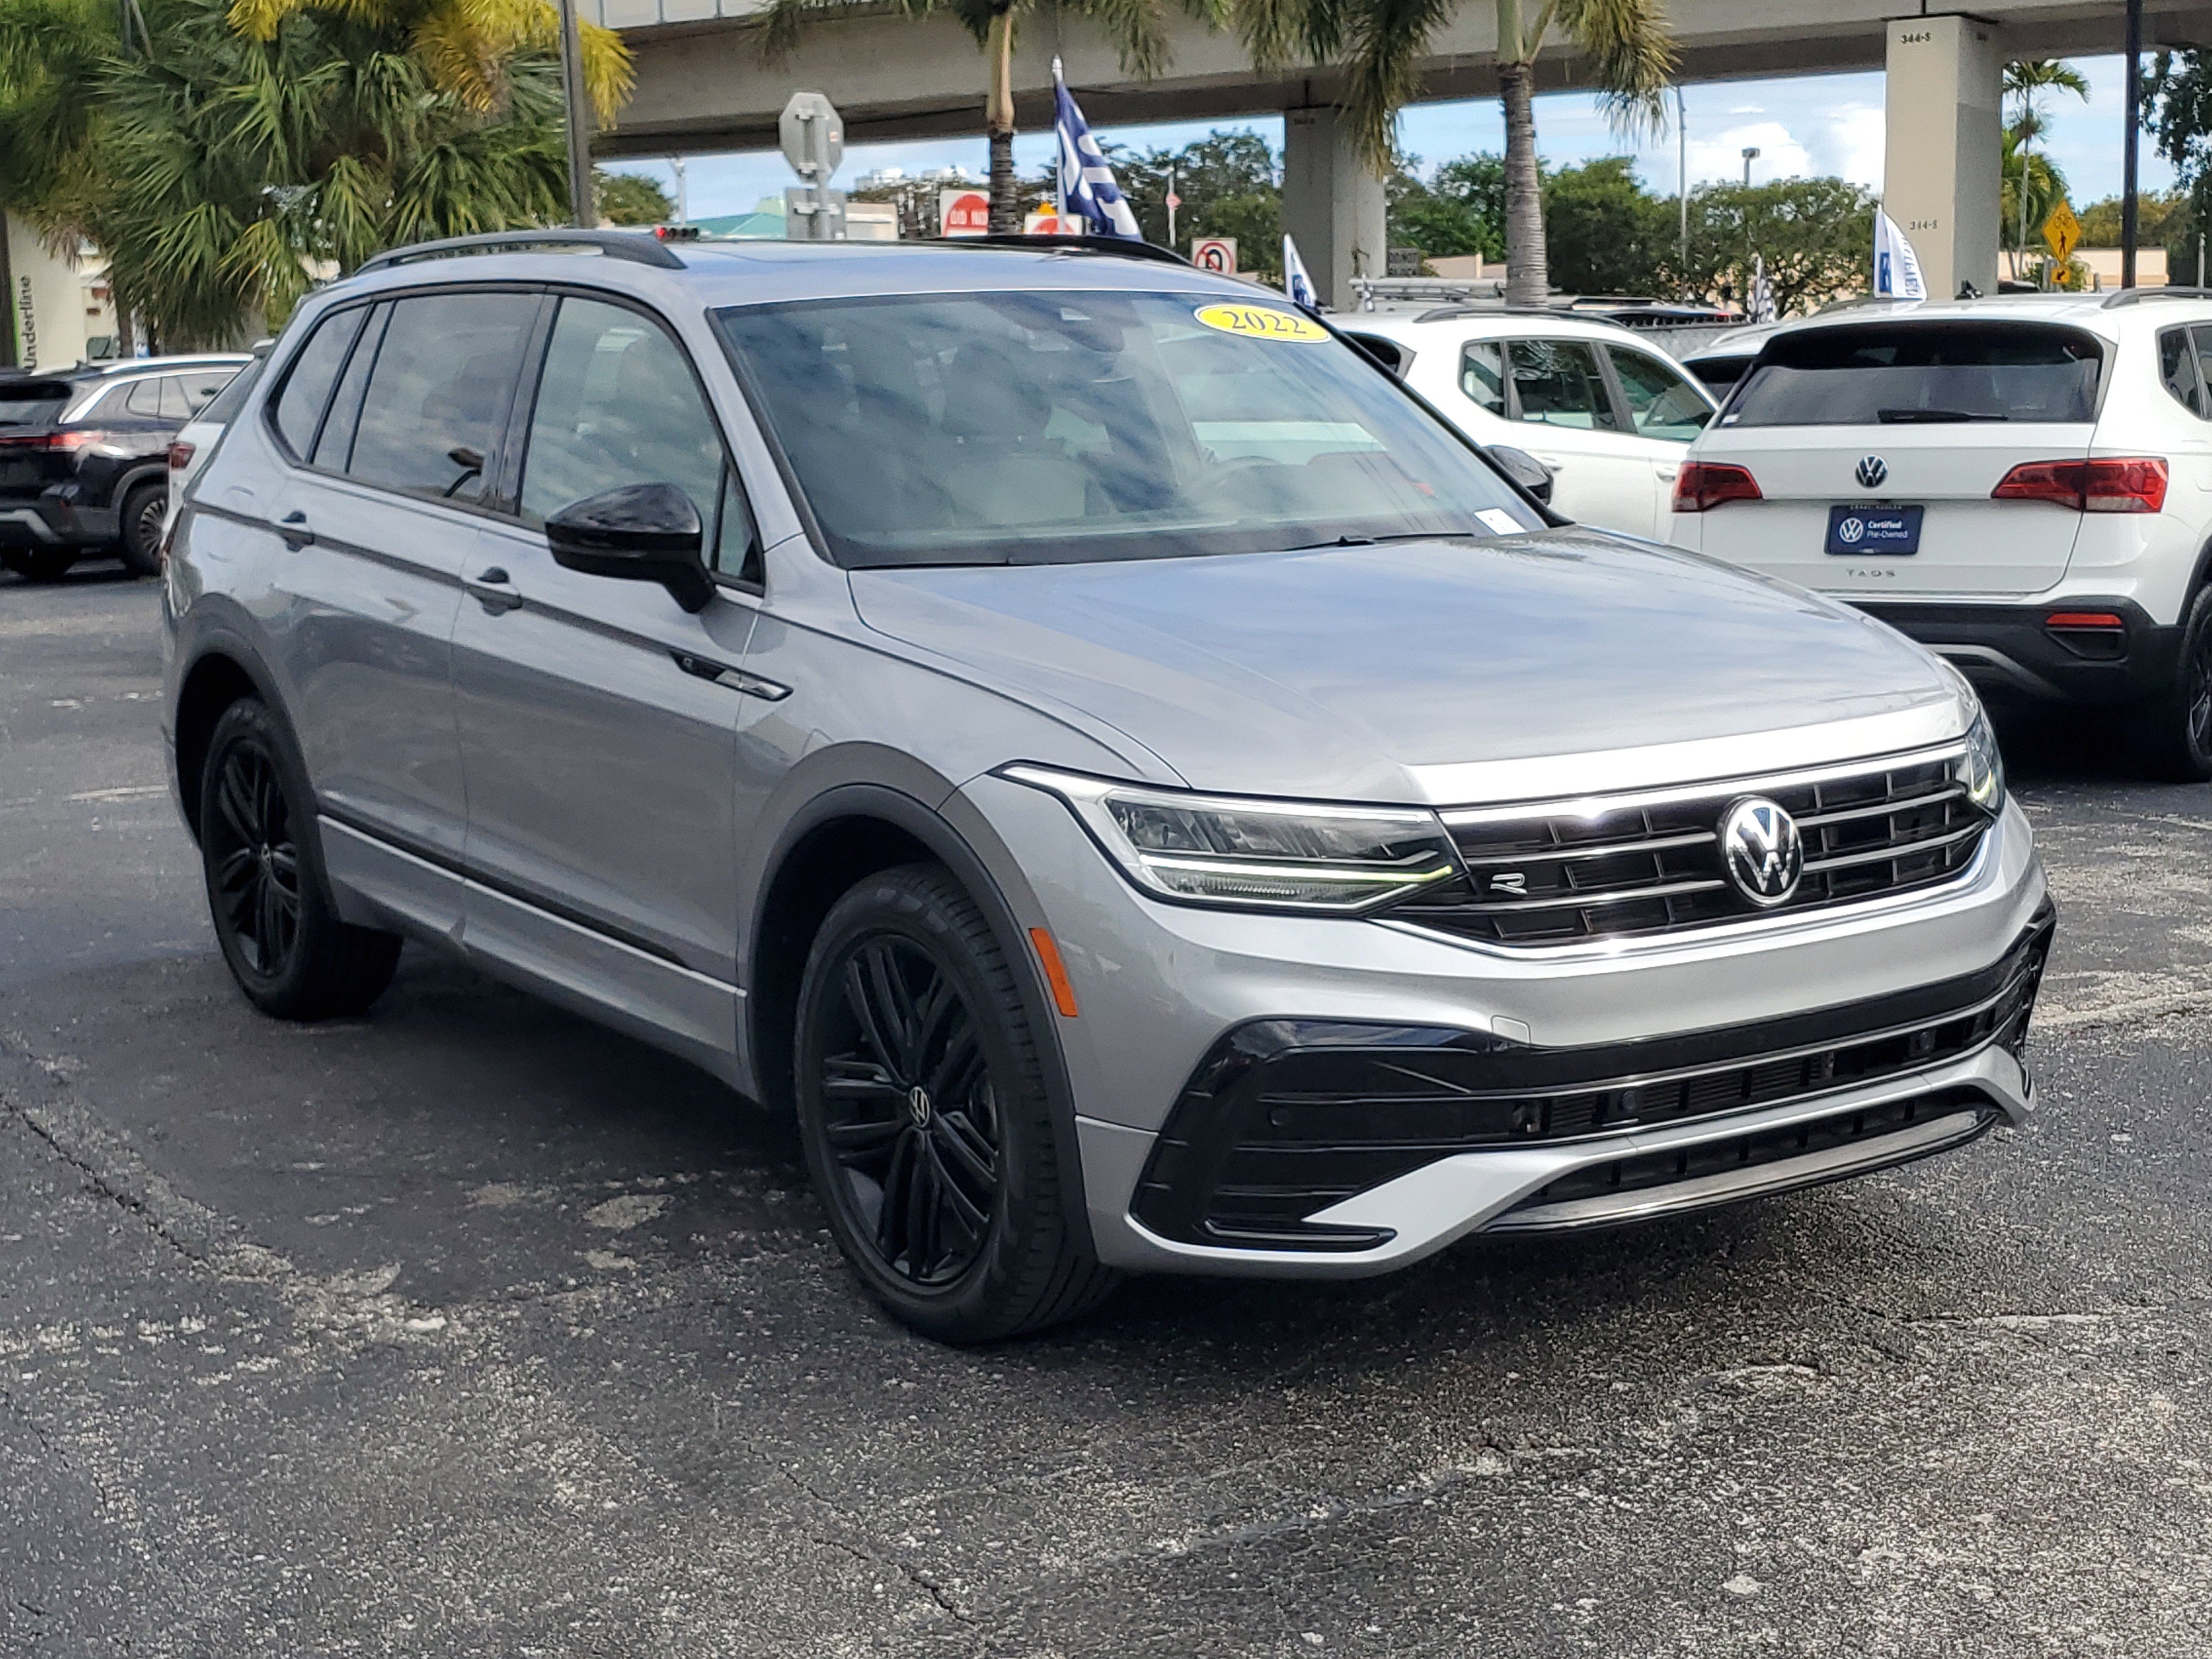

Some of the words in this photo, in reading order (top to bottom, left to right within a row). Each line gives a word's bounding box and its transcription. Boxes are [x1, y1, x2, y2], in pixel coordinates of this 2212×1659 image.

[1221, 311, 1307, 334] 2022
[1867, 521, 1902, 529] Certified
[1867, 530, 1908, 538] Pre-Owned
[1846, 569, 1895, 577] TAOS
[1491, 873, 1528, 895] R
